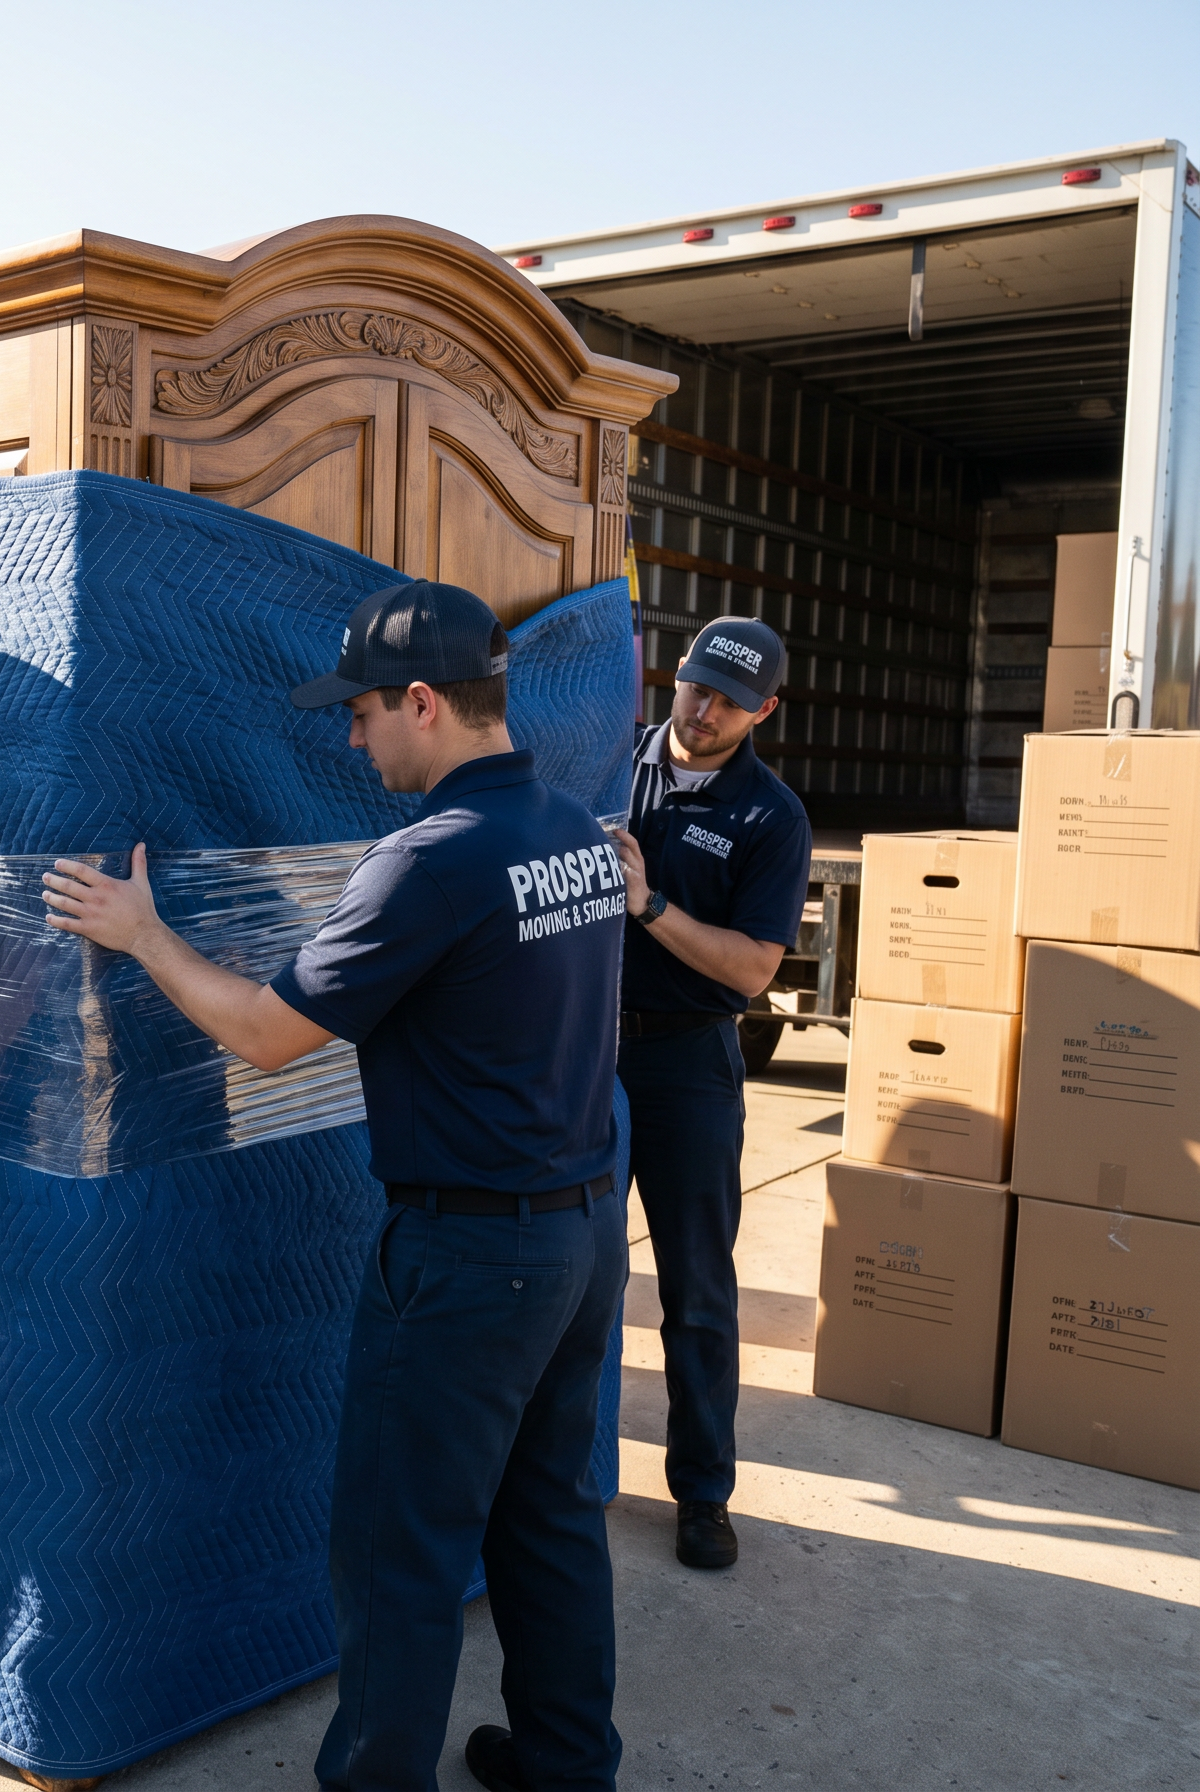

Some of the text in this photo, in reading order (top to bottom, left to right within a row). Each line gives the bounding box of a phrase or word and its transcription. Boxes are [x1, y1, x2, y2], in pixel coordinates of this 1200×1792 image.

[709, 635, 763, 667] PROSPER
[685, 823, 733, 854] PROSPER
[506, 843, 625, 914] PROSPER
[518, 892, 626, 942] MOVING & STORAGE
[852, 1298, 875, 1309] DATE
[1049, 1342, 1075, 1355] DATE
